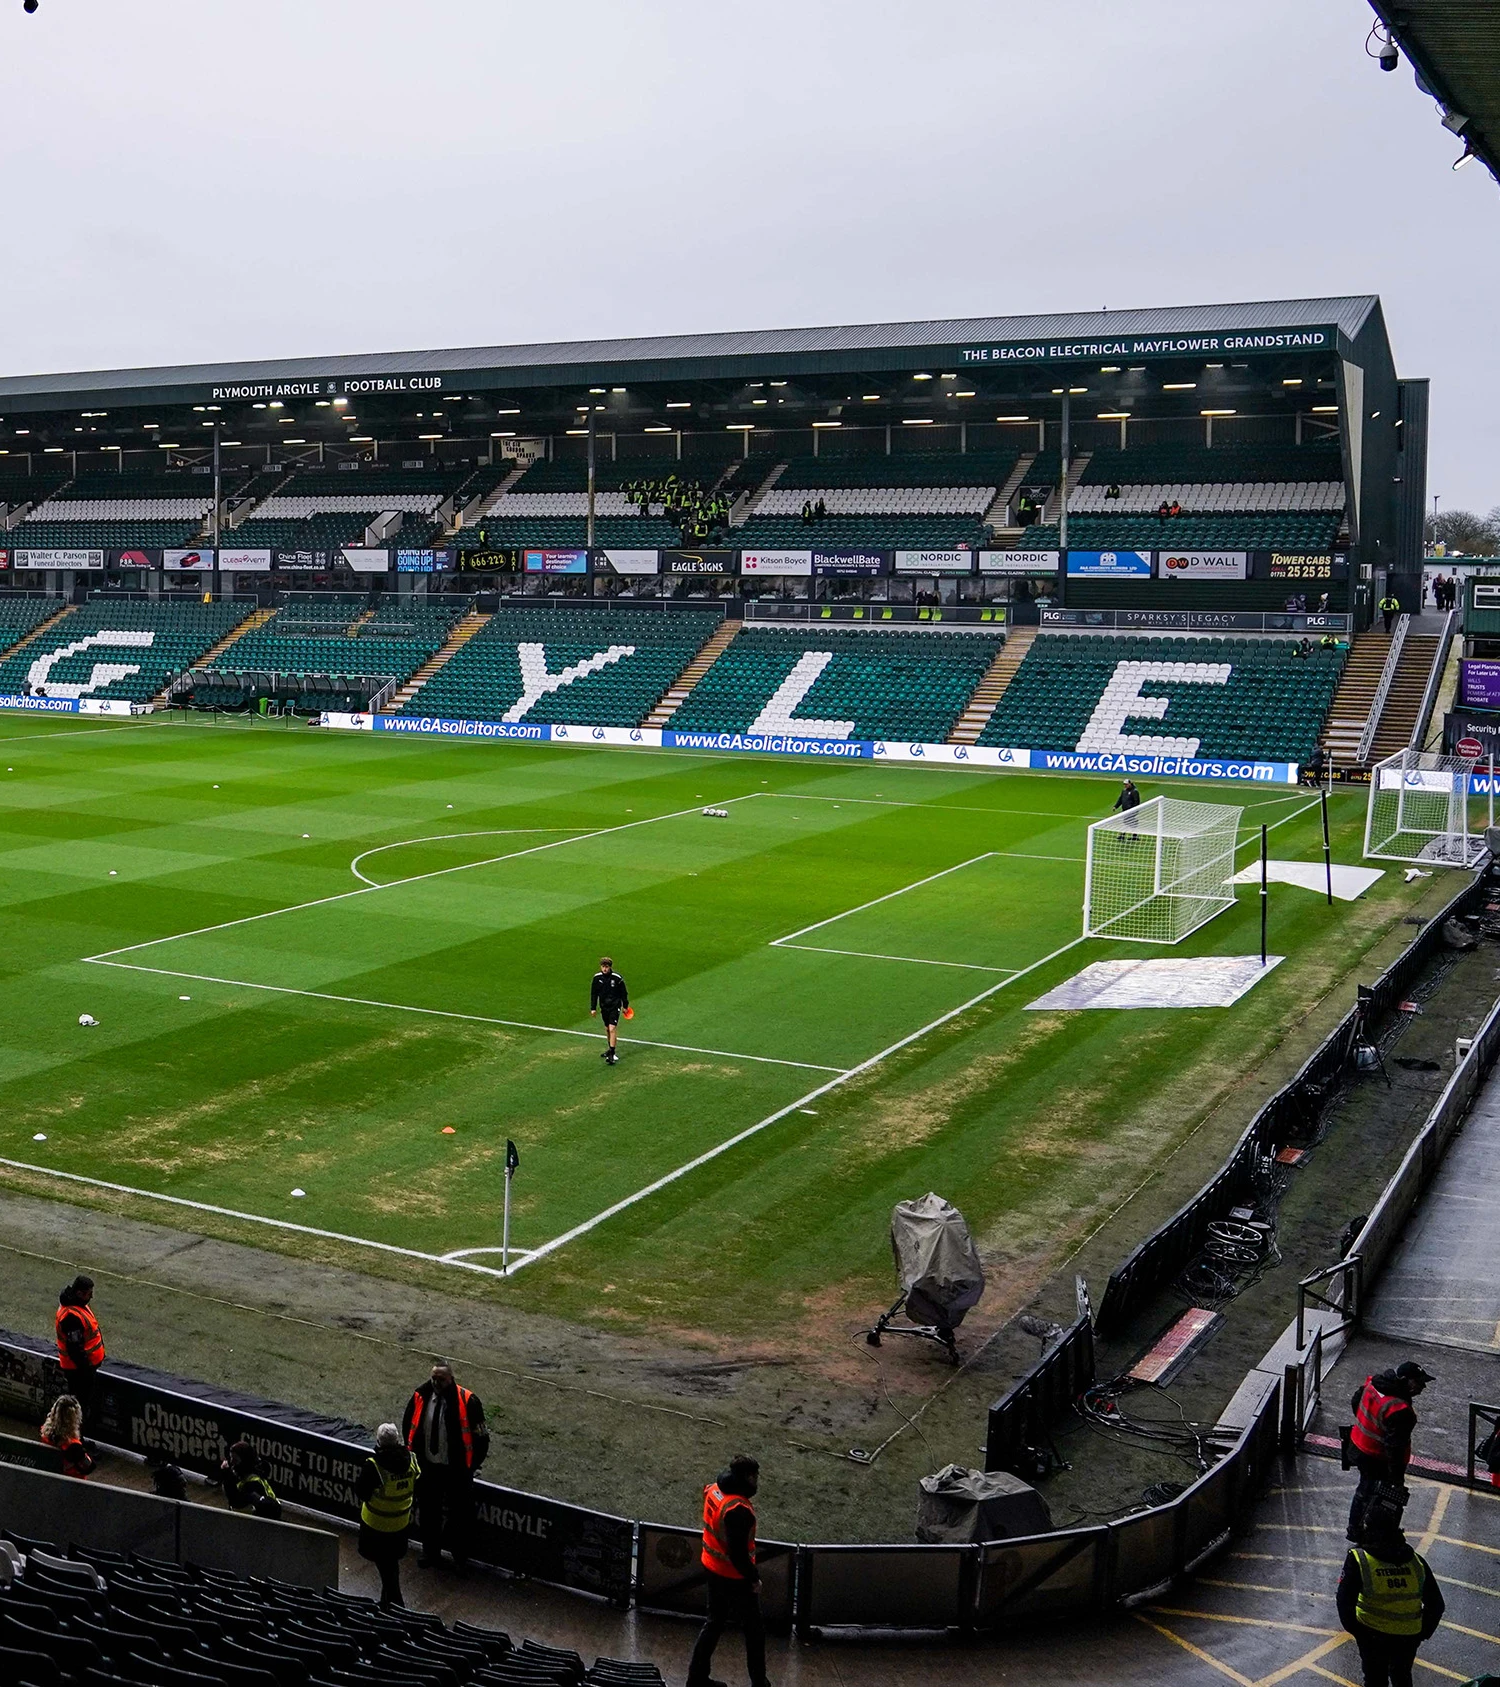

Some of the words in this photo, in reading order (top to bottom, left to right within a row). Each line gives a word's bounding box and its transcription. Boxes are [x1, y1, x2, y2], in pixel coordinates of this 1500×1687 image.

[963, 350, 987, 361] THE
[992, 347, 1045, 360] BEACON
[1050, 343, 1129, 358] ELECTRICAL
[1133, 338, 1219, 354] MAYFLOWER
[1224, 333, 1325, 349] GRANDSTAND
[212, 386, 273, 399] PLYMOUTH
[275, 383, 320, 395] ARGYLE
[344, 379, 406, 392] FOOTBALL
[409, 377, 442, 389] CLUB
[397, 556, 420, 566] GOING
[421, 556, 433, 566] UP!
[471, 555, 504, 567] 666-222
[760, 556, 783, 564] Kitson
[785, 556, 807, 566] Boyce
[814, 555, 880, 565] BlackwellBate
[920, 553, 961, 561] NORDIC
[1005, 553, 1048, 562] NORDIC
[1190, 557, 1199, 566] D
[1203, 557, 1239, 566] WALL
[1271, 553, 1304, 565] TOWER
[1305, 554, 1331, 565] CABS
[672, 563, 698, 572] EAGLE
[699, 562, 723, 572] SIGNS
[1287, 566, 1301, 577] 25
[1302, 566, 1316, 577] 25
[1317, 566, 1331, 577] 25
[1043, 612, 1059, 620] PLG
[1127, 613, 1187, 622] SPARKSY'S
[1190, 614, 1237, 622] LEGACY
[1307, 617, 1325, 625] PLG
[384, 717, 541, 739] www.GAsolicitors.com
[1467, 723, 1497, 735] Security
[675, 733, 861, 757] www.GAsolicitors.com
[1046, 753, 1273, 780] www.GAsolicitors.com
[144, 1401, 219, 1439] Choose
[131, 1416, 228, 1462] Respect
[305, 1450, 328, 1474] TO
